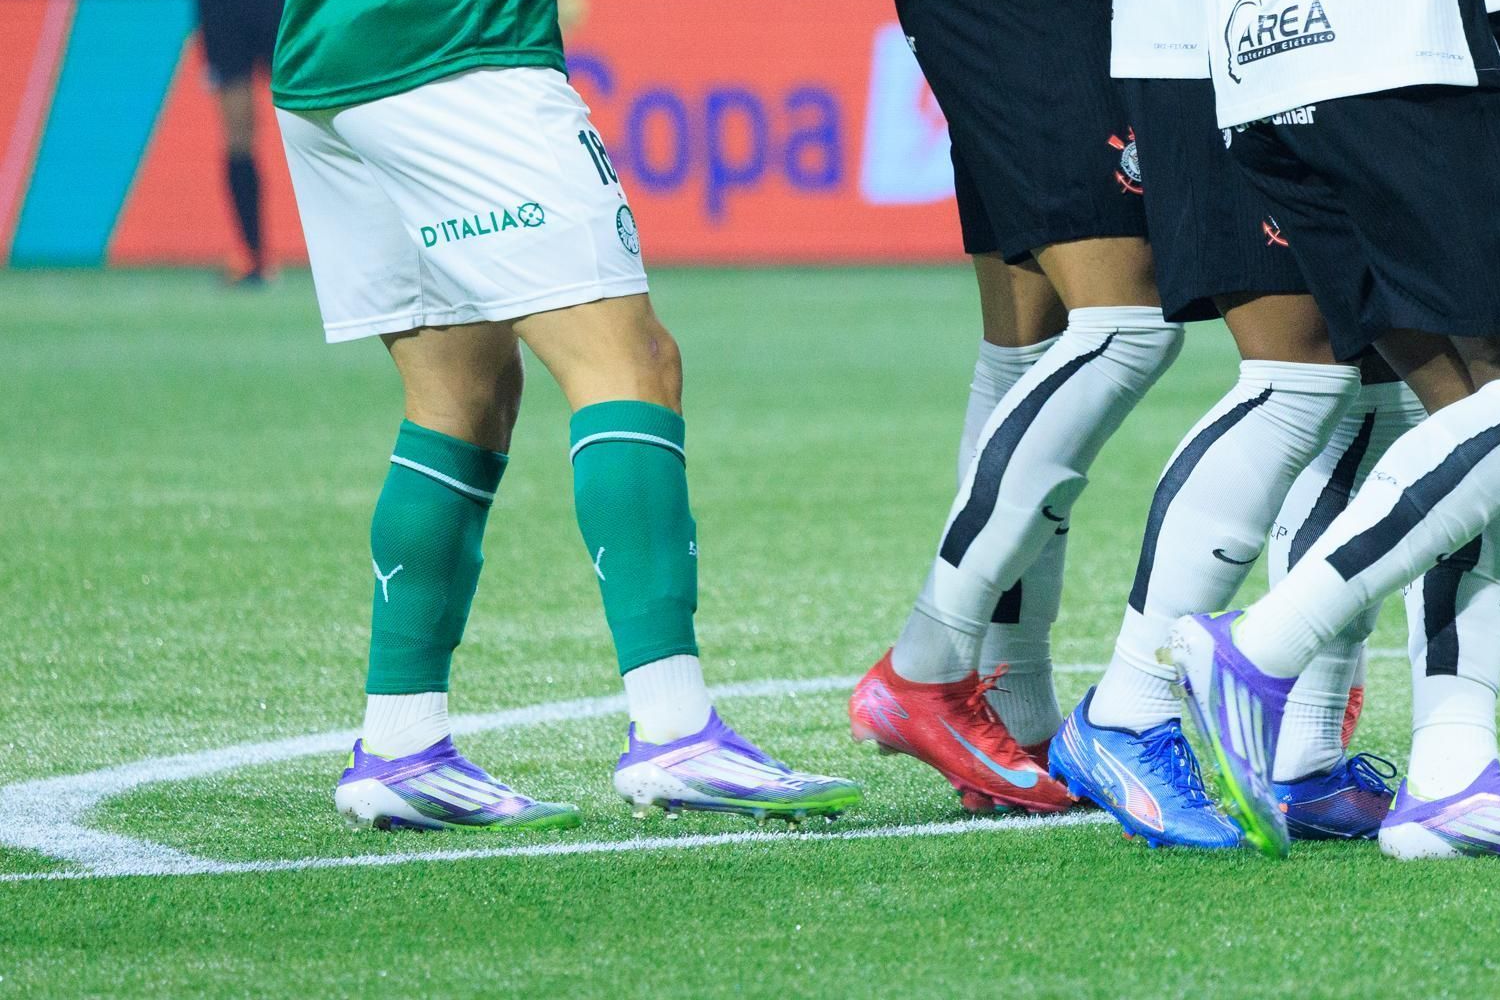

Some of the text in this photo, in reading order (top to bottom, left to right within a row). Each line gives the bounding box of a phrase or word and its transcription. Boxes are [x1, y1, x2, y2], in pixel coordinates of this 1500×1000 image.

[1238, 32, 1334, 64] Material Elétrico
[579, 130, 618, 187] 18
[421, 208, 520, 249] D'ITALIA
